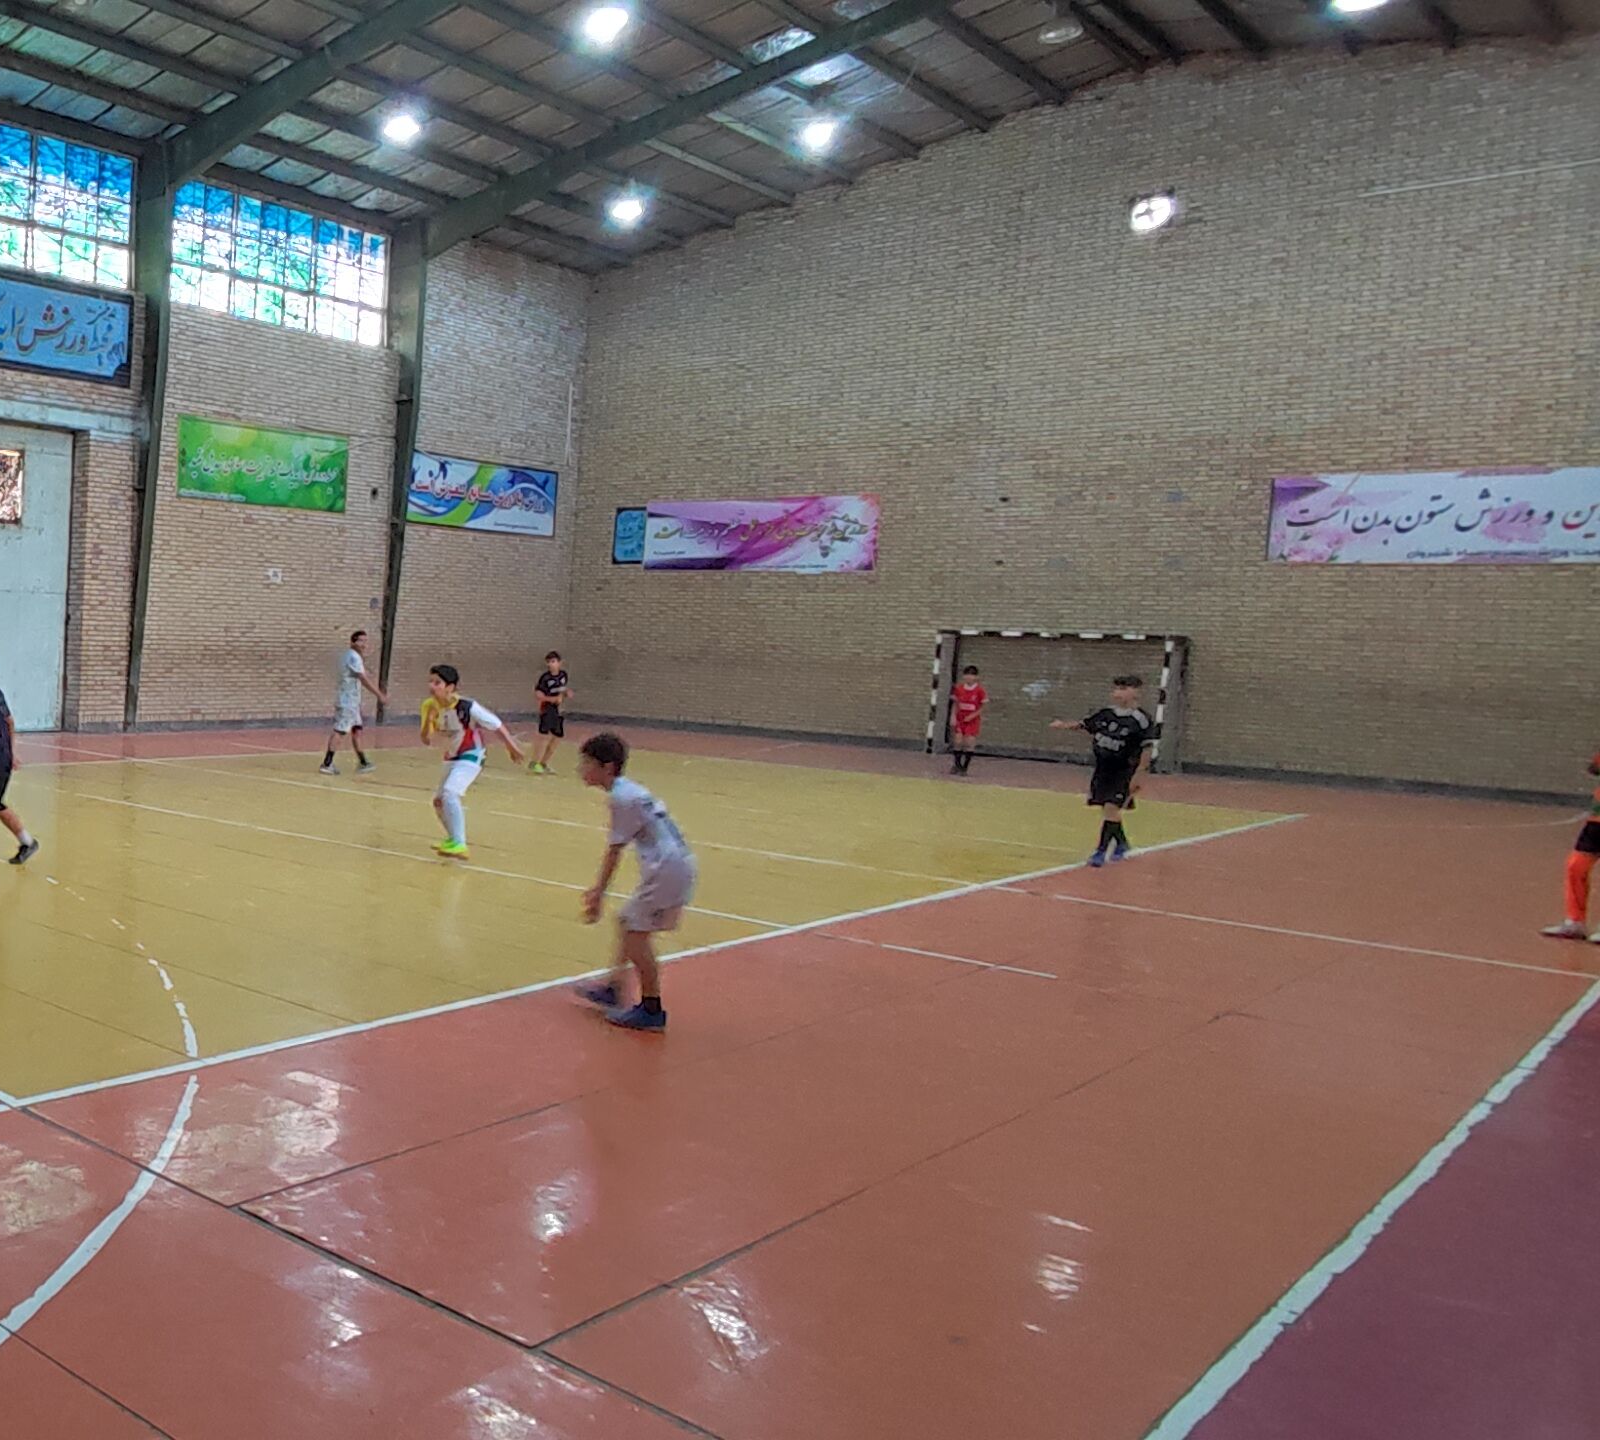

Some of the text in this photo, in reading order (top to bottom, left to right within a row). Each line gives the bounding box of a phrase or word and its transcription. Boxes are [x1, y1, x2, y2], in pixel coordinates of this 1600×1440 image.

[16, 304, 86, 352] ورزش
[1286, 508, 1350, 528] است
[1351, 509, 1393, 546] بدن
[1394, 494, 1455, 534] ستون
[1454, 487, 1536, 532] ورزش
[1540, 510, 1555, 526] و
